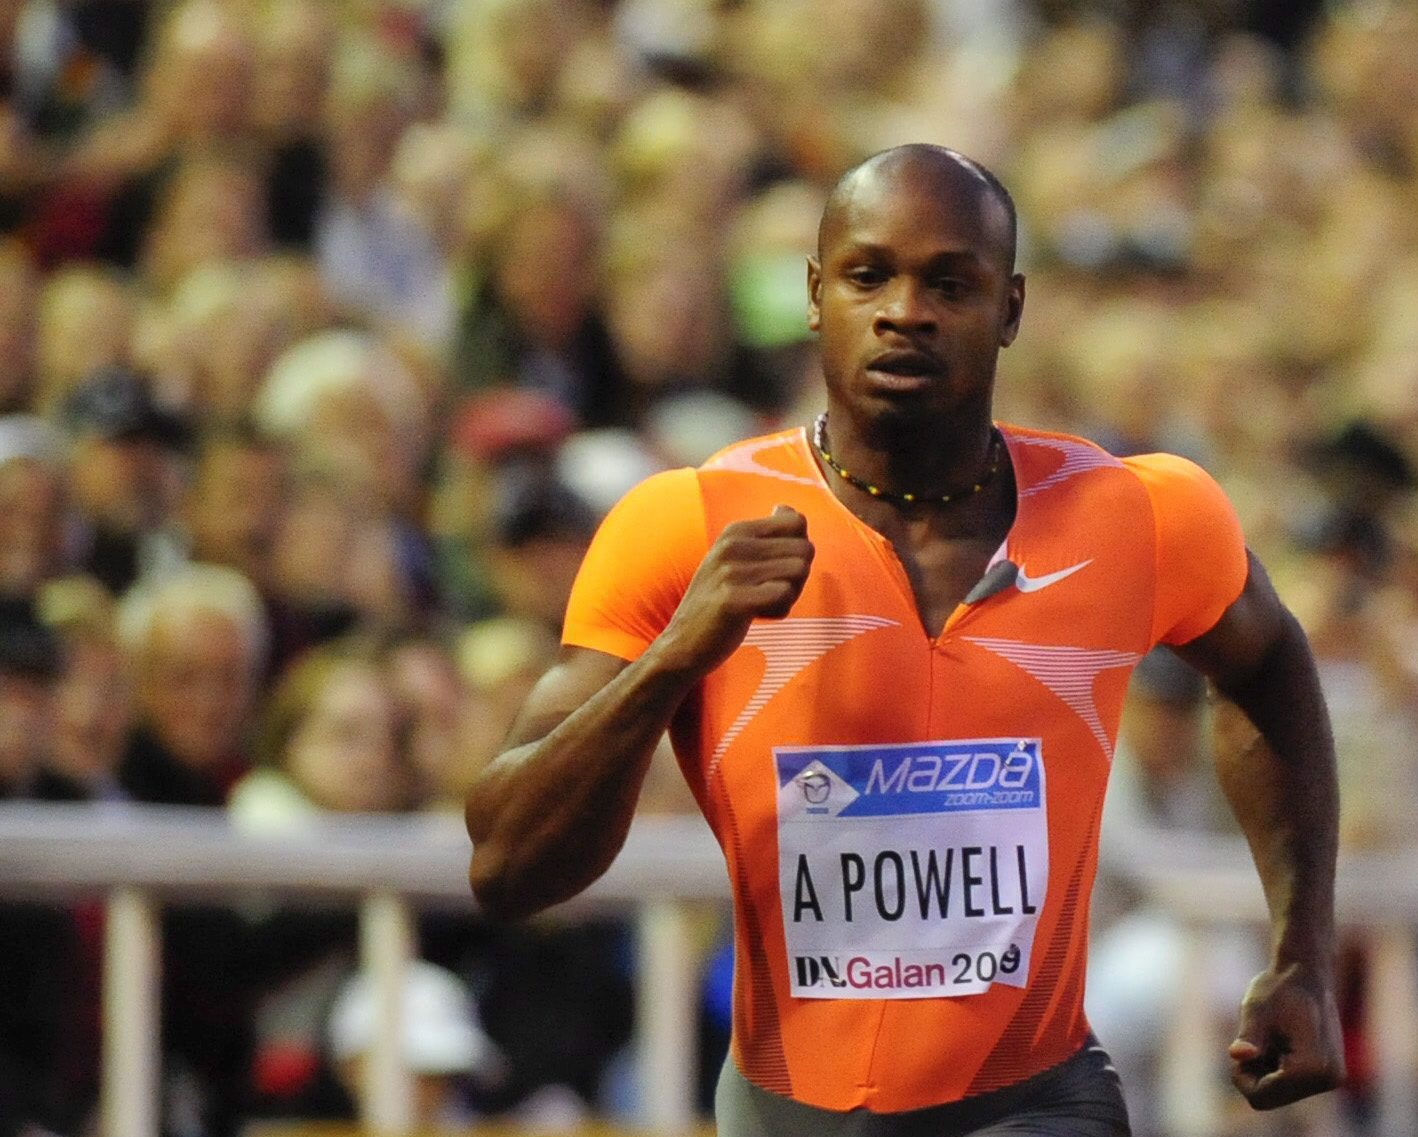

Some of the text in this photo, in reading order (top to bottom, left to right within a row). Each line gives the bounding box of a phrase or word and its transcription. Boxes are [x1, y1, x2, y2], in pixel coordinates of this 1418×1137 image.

[944, 790, 1034, 806] zoom-zoom
[793, 845, 1036, 922] A POWELL
